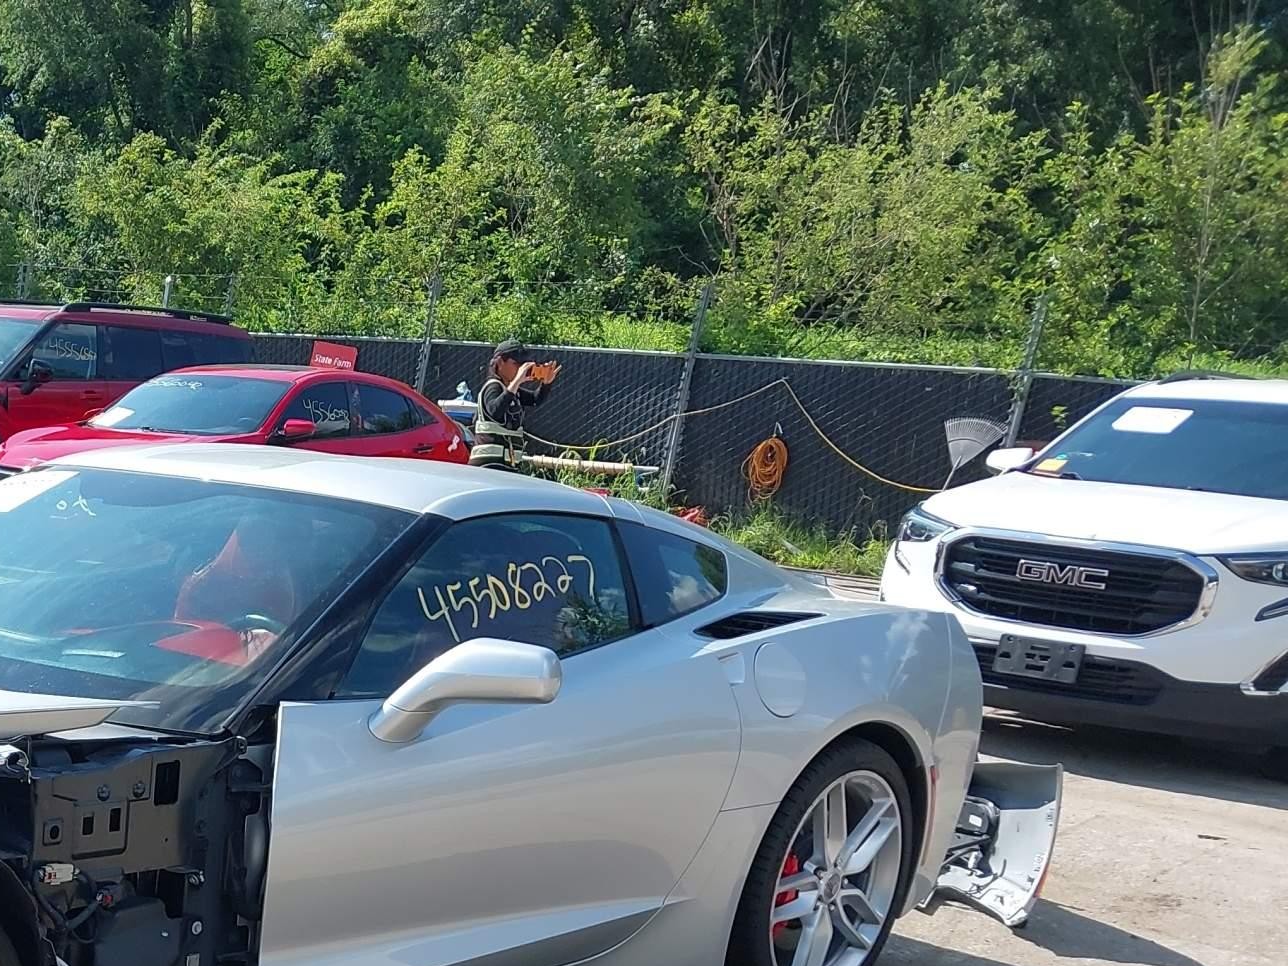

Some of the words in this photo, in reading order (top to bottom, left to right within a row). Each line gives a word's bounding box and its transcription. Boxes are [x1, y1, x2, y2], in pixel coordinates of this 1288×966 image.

[314, 354, 332, 365] State
[333, 357, 352, 369] Farm
[1016, 559, 1109, 590] GMC
[417, 555, 595, 642] 45508227
